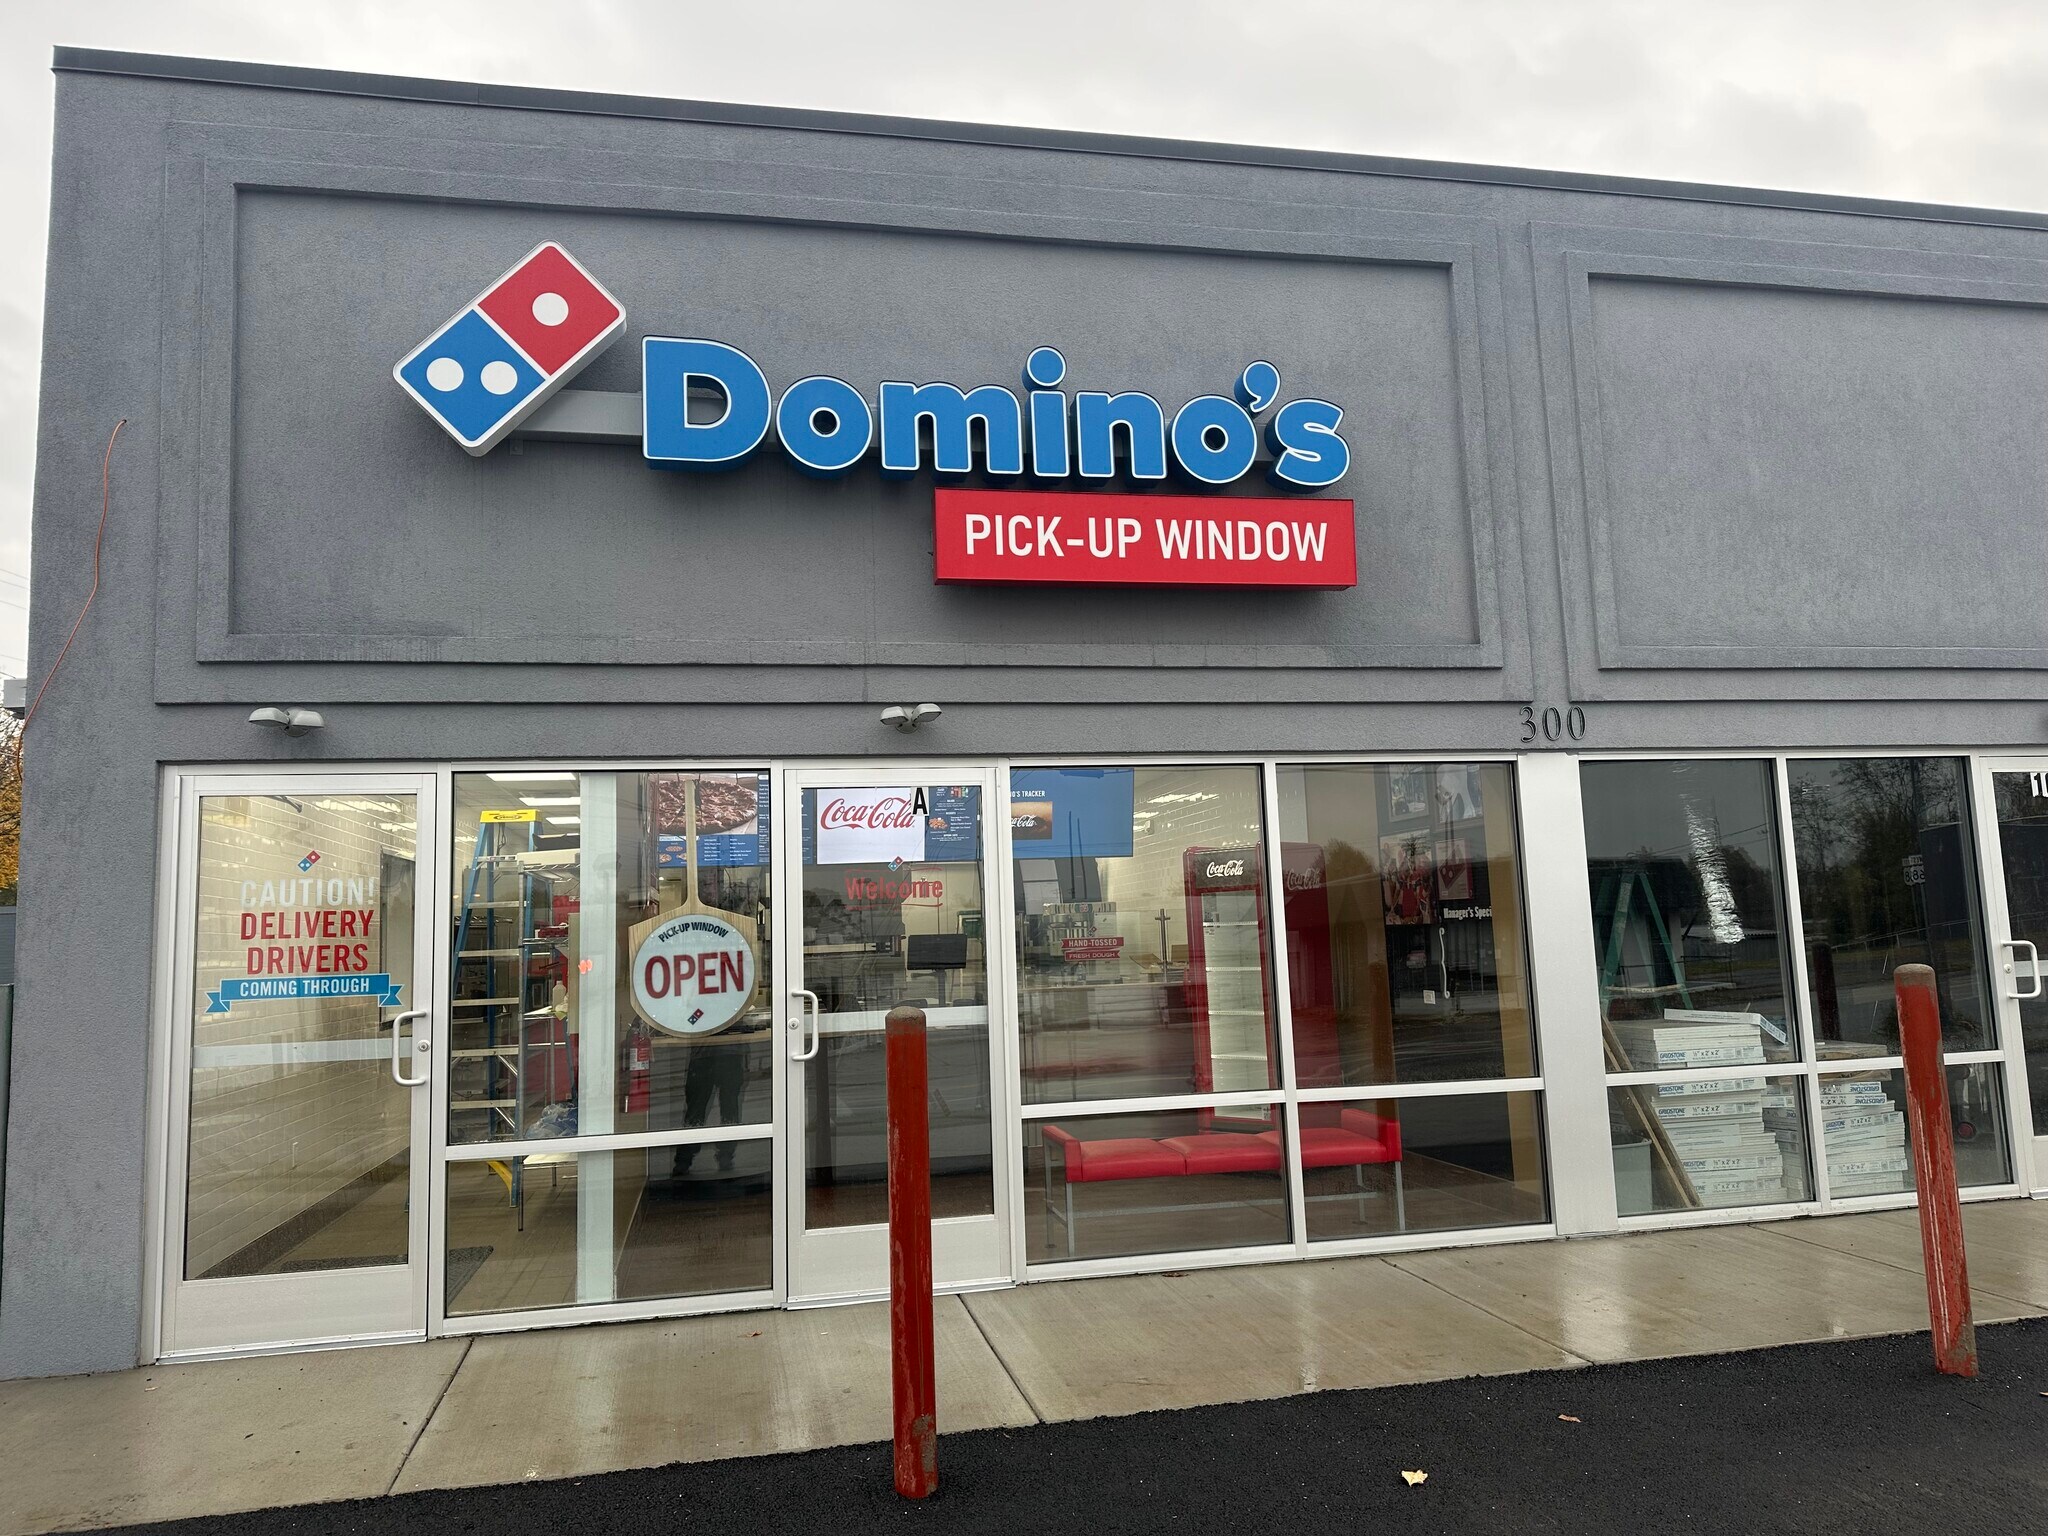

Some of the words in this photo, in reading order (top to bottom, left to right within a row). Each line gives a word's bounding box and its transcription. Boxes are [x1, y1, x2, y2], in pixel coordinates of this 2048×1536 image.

[641, 335, 1352, 487] Domino's
[965, 514, 1142, 558] PICK-UP
[1157, 518, 1328, 562] WINDOW
[1519, 705, 1586, 743] 300
[912, 787, 928, 815] A
[1022, 790, 1046, 798] TRACKER
[1206, 859, 1245, 878] Coca-Cola
[240, 876, 375, 908] CAUTION!
[845, 877, 943, 901] Welcome
[240, 909, 375, 940] DELIVERY
[658, 922, 690, 943] PICK-UP
[691, 921, 729, 938] WINDOW
[1069, 939, 1118, 947] HAND-TOSSED
[1069, 951, 1090, 959] FRESH
[247, 943, 369, 975] DRIVERS
[240, 979, 297, 997] COMING
[302, 977, 370, 995] THROUGH
[644, 950, 745, 999] OPEN
